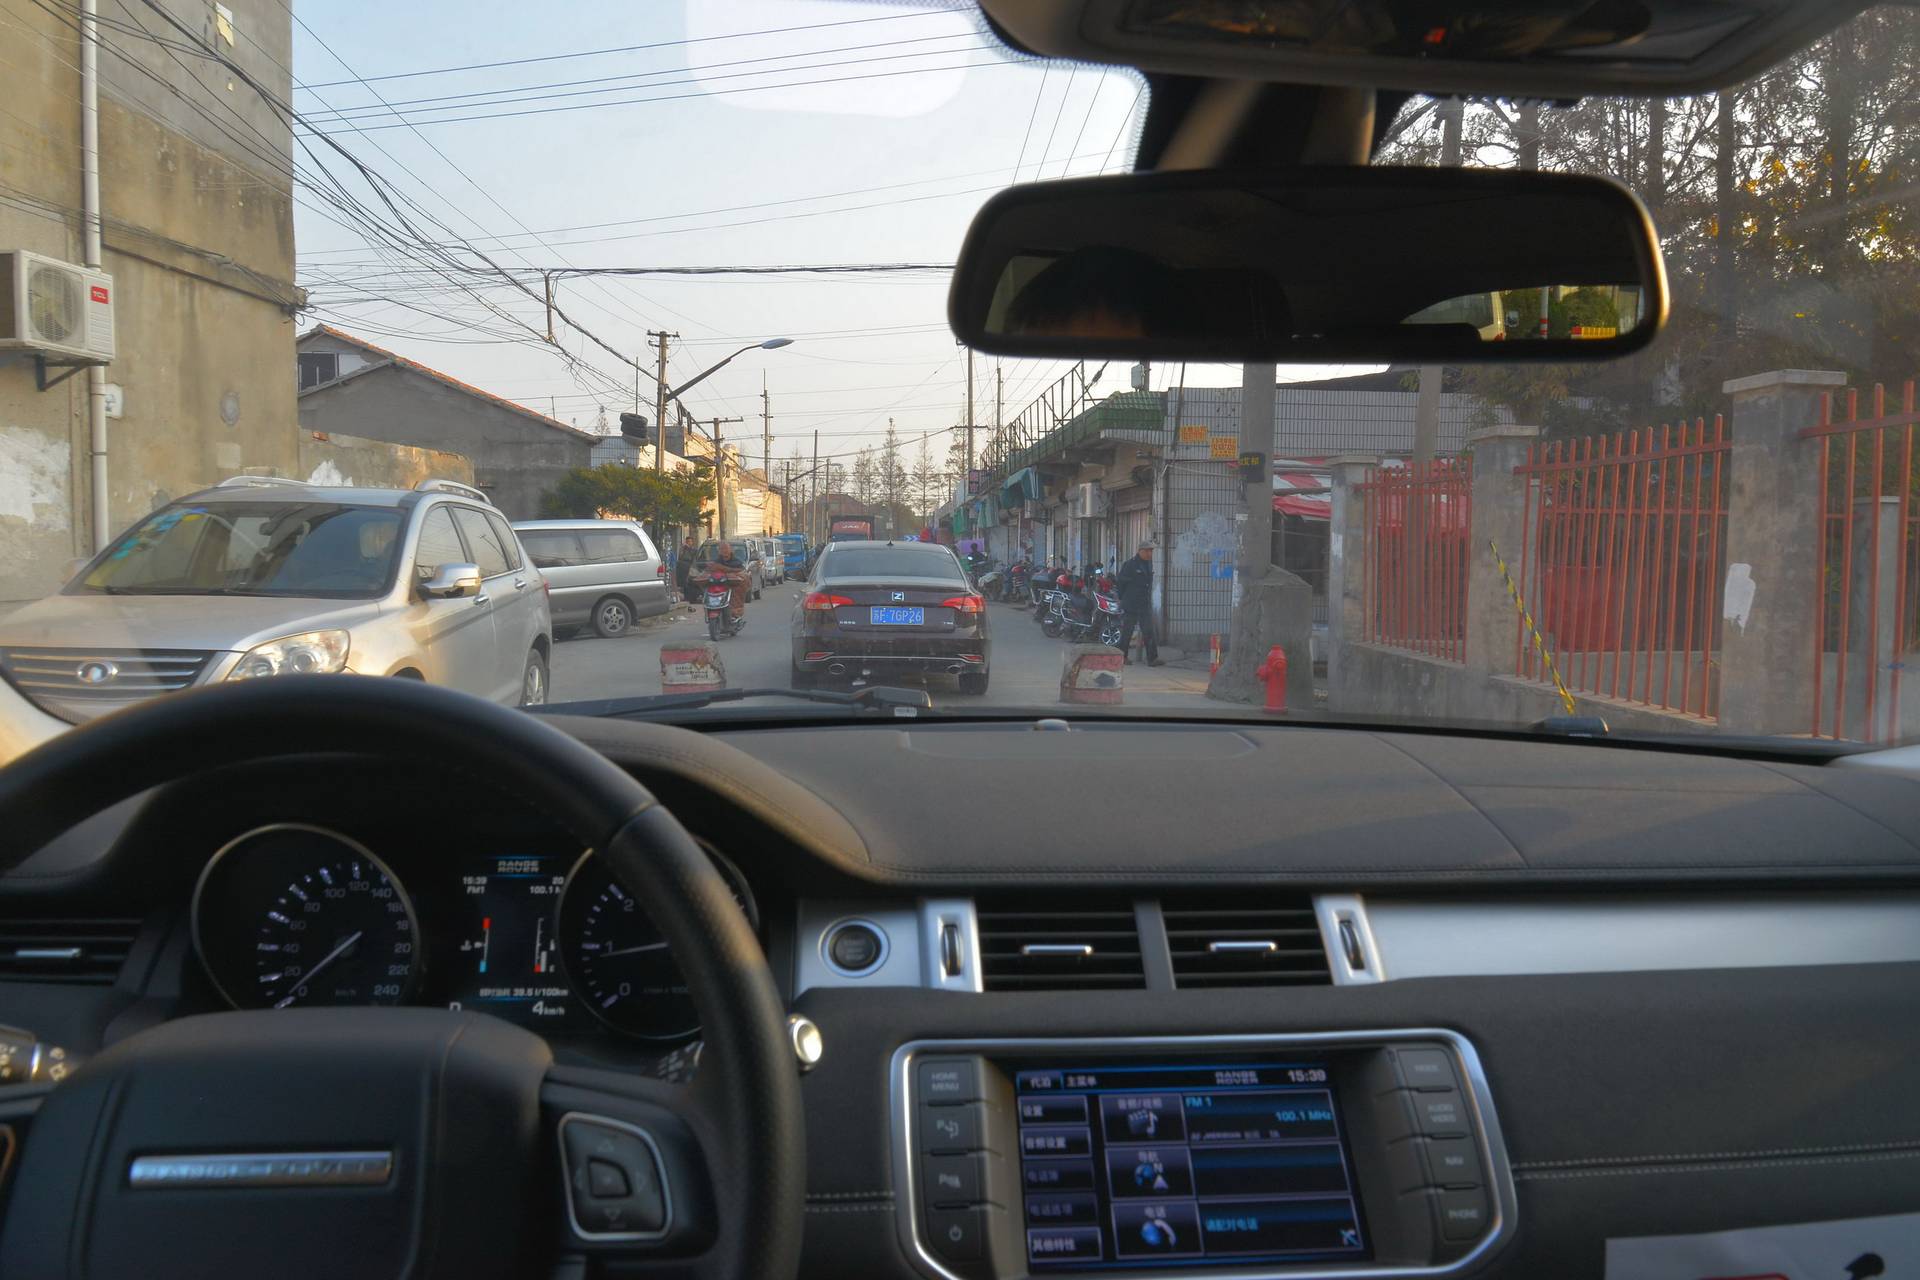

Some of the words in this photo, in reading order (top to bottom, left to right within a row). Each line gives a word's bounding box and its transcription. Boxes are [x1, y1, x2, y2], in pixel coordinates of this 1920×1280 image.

[623, 899, 634, 912] 2
[374, 985, 400, 995] 240
[619, 982, 631, 996] 0
[1288, 1069, 1327, 1082] 15:39
